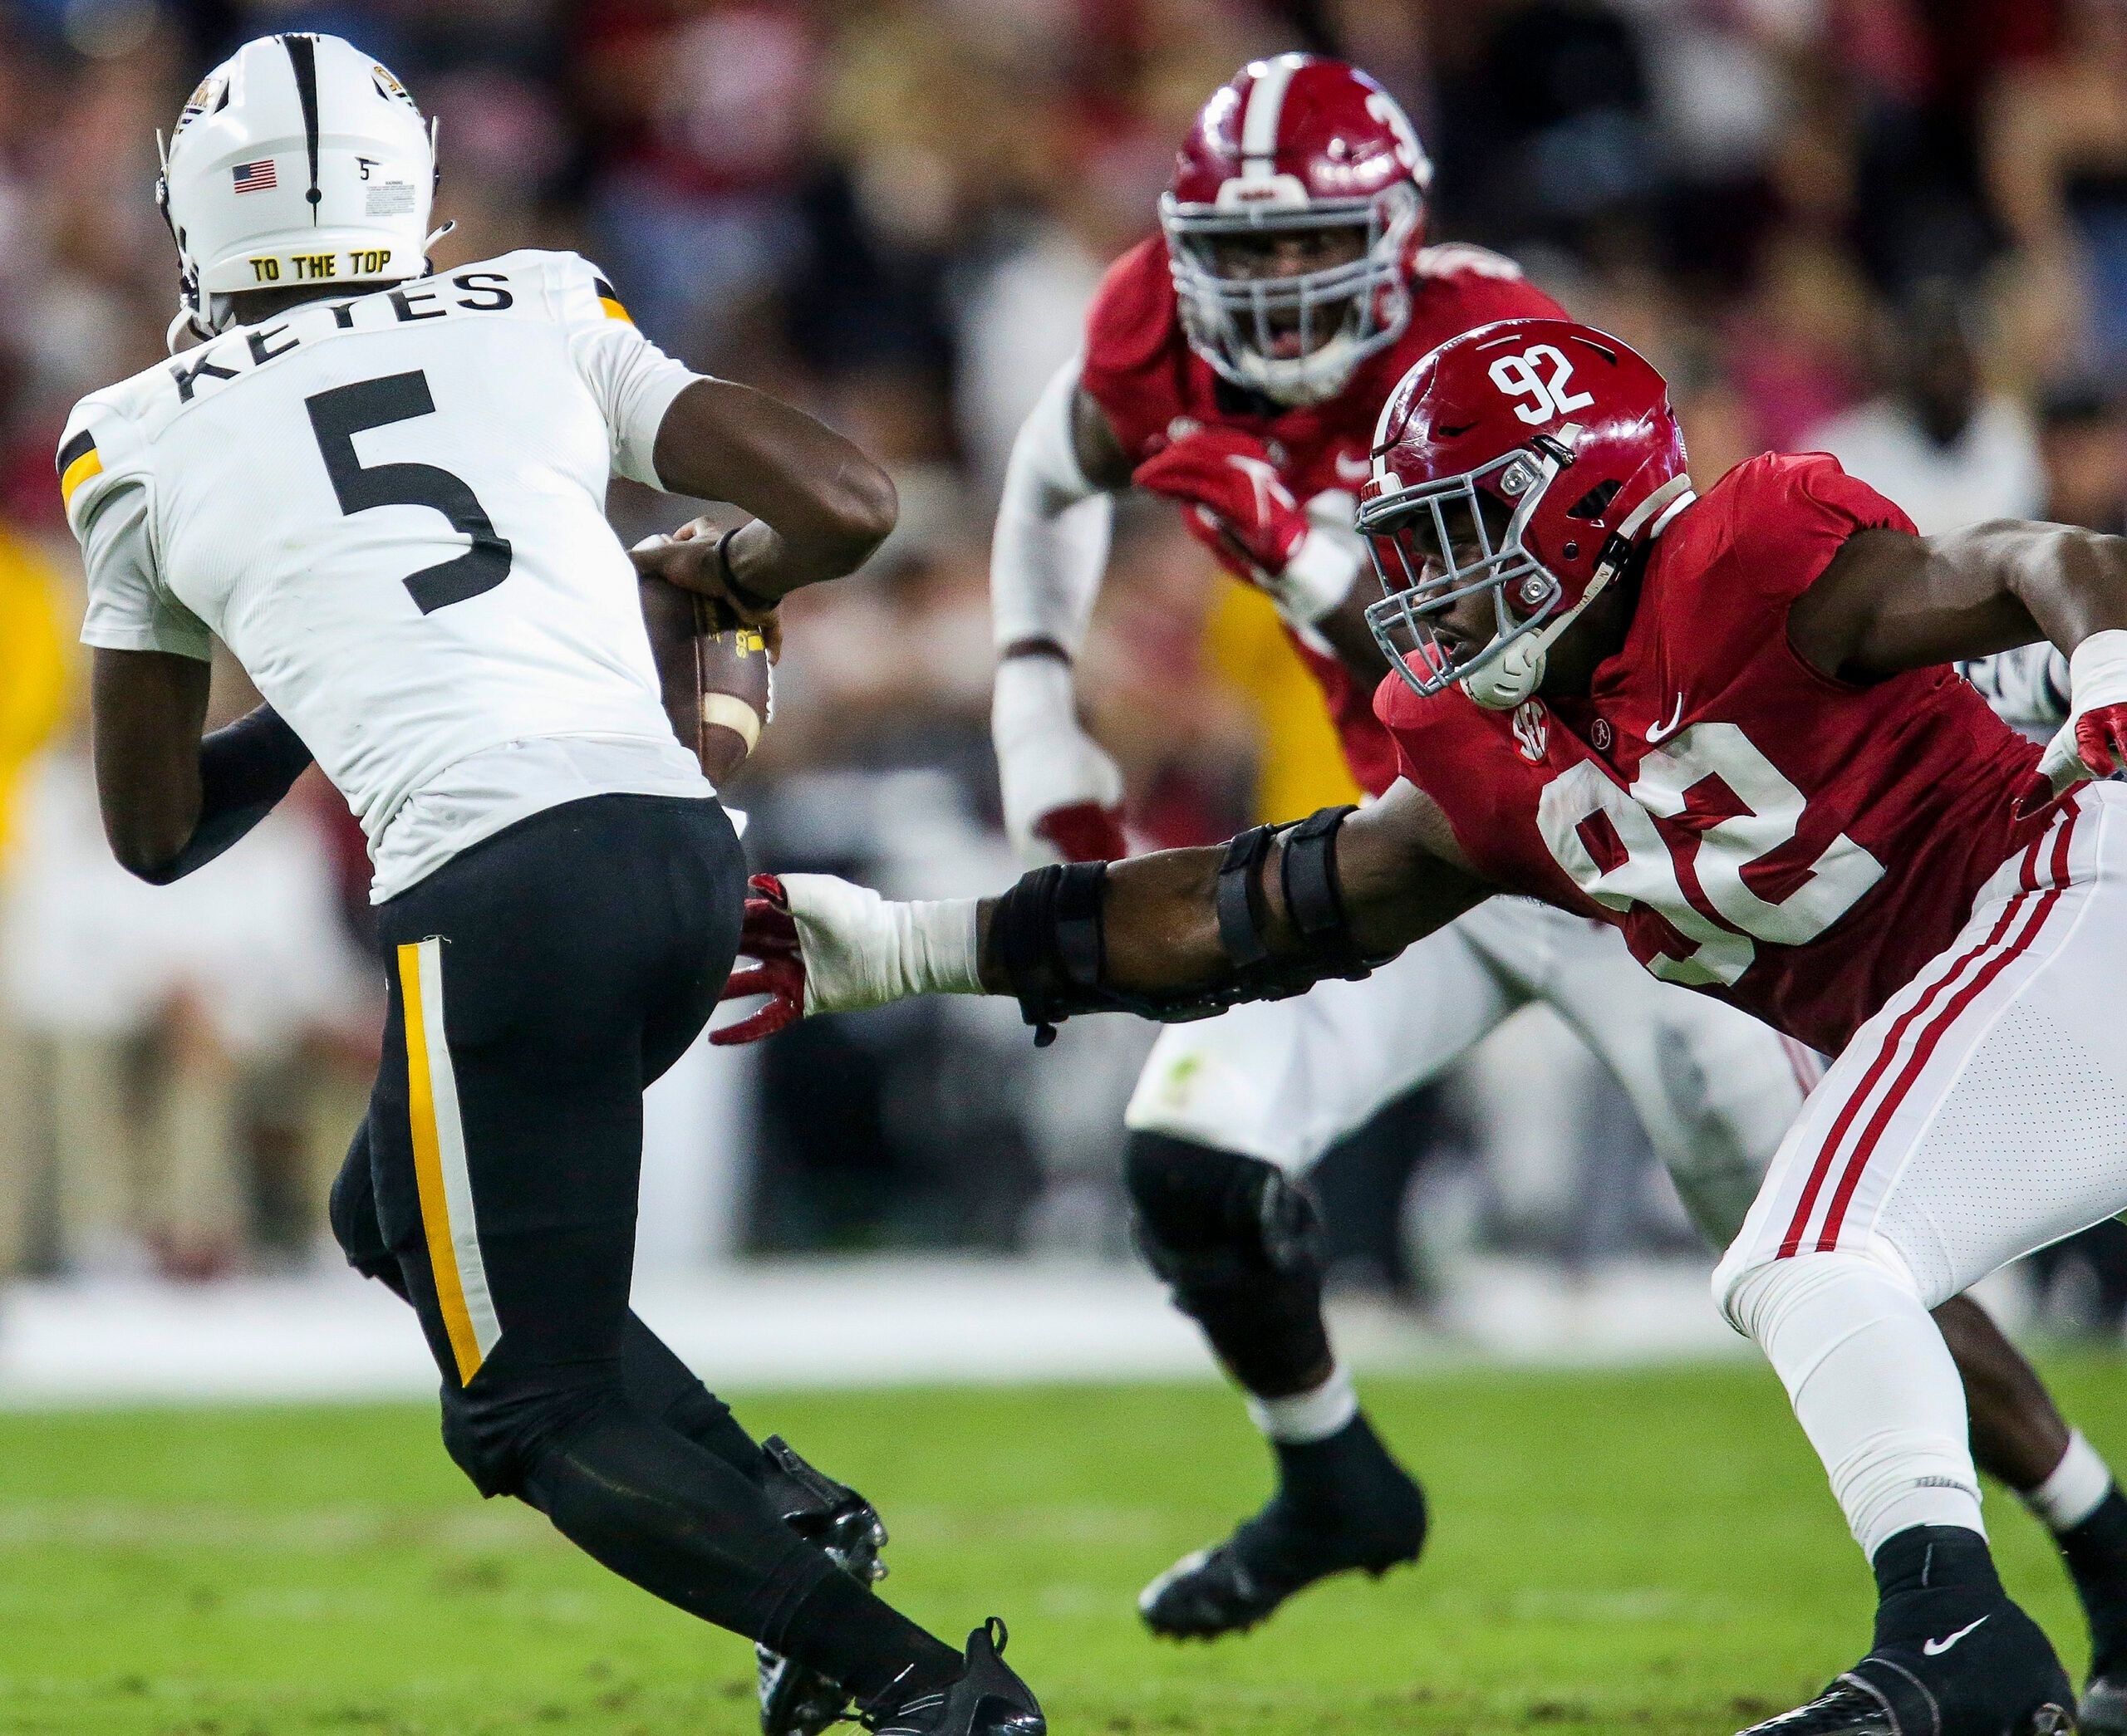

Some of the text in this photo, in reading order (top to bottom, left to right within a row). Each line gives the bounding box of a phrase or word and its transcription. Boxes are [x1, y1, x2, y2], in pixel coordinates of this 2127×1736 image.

[249, 250, 391, 282] TO THE TOP
[169, 273, 513, 405] KEYES
[1488, 344, 1595, 425] 92
[304, 369, 512, 615] 5
[1512, 701, 1546, 762] SEC
[1535, 722, 1888, 988] 92
